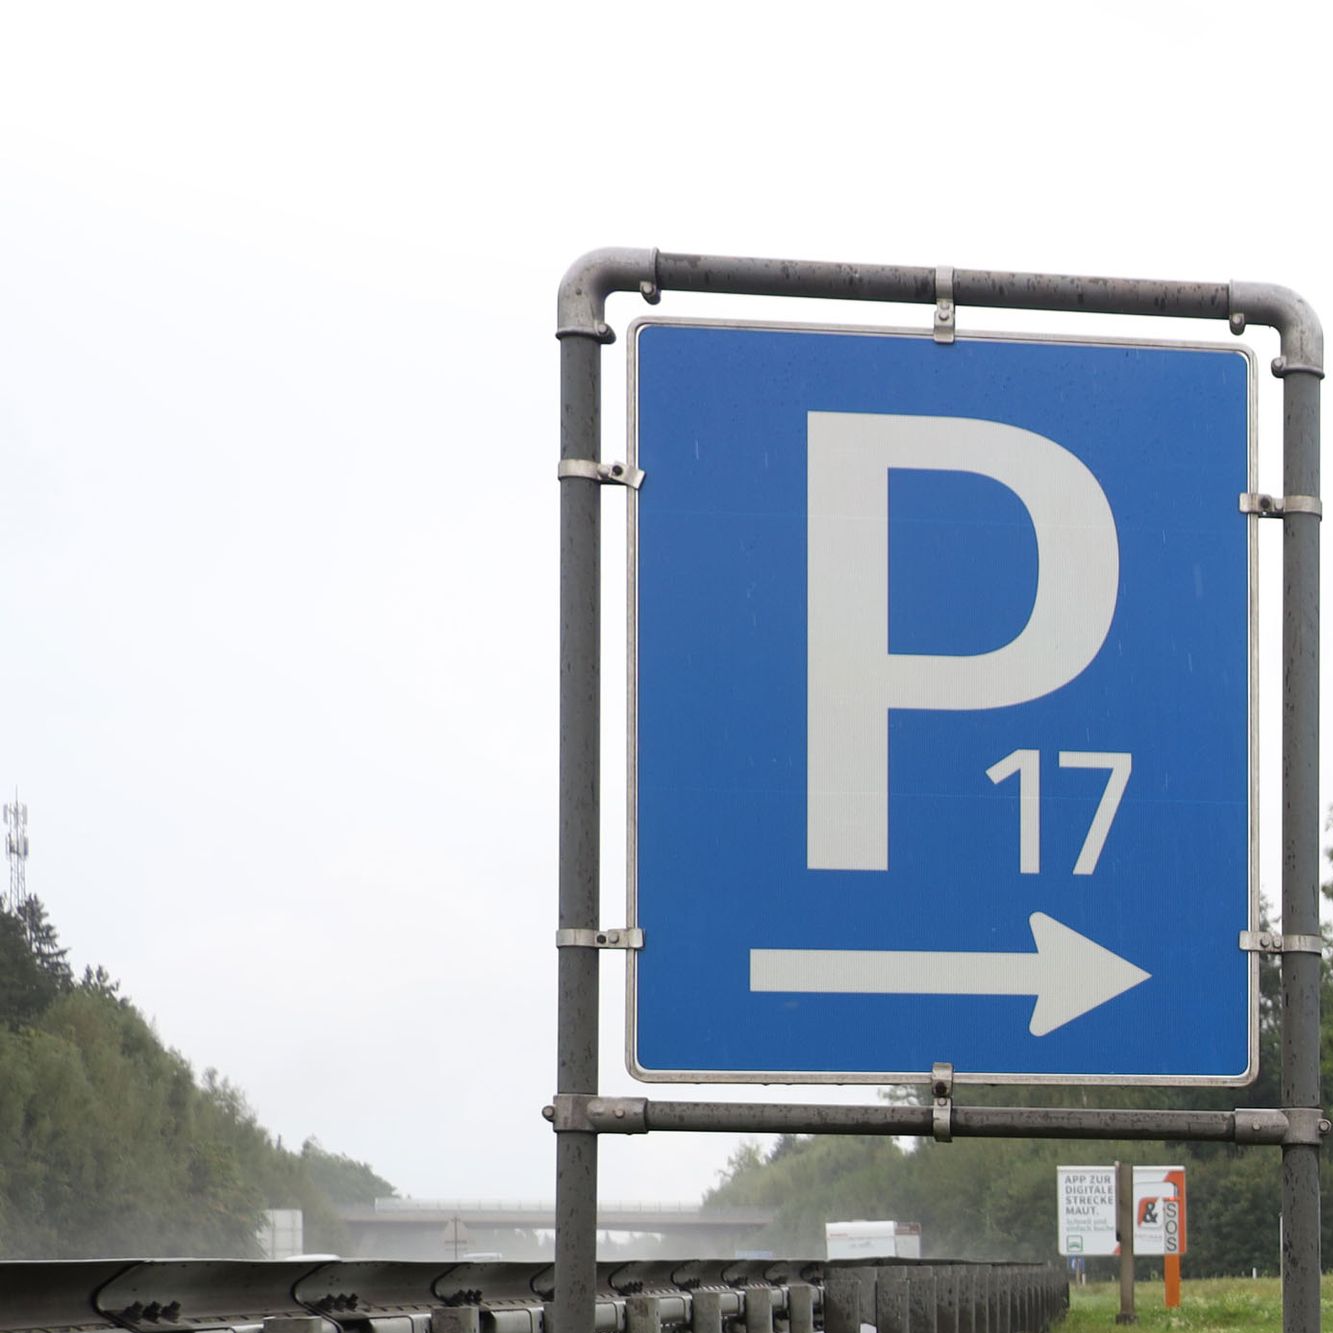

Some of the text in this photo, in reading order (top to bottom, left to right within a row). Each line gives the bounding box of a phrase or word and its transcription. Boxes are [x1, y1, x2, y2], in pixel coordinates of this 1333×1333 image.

[806, 410, 1120, 871] P
[985, 749, 1133, 876] 17
[1064, 1175, 1112, 1185] APP ZUR
[1065, 1185, 1114, 1195] DIGITALE
[1065, 1195, 1114, 1205] STRECKE
[1065, 1205, 1100, 1215] MAUT.
[1165, 1202, 1178, 1252] SOS
